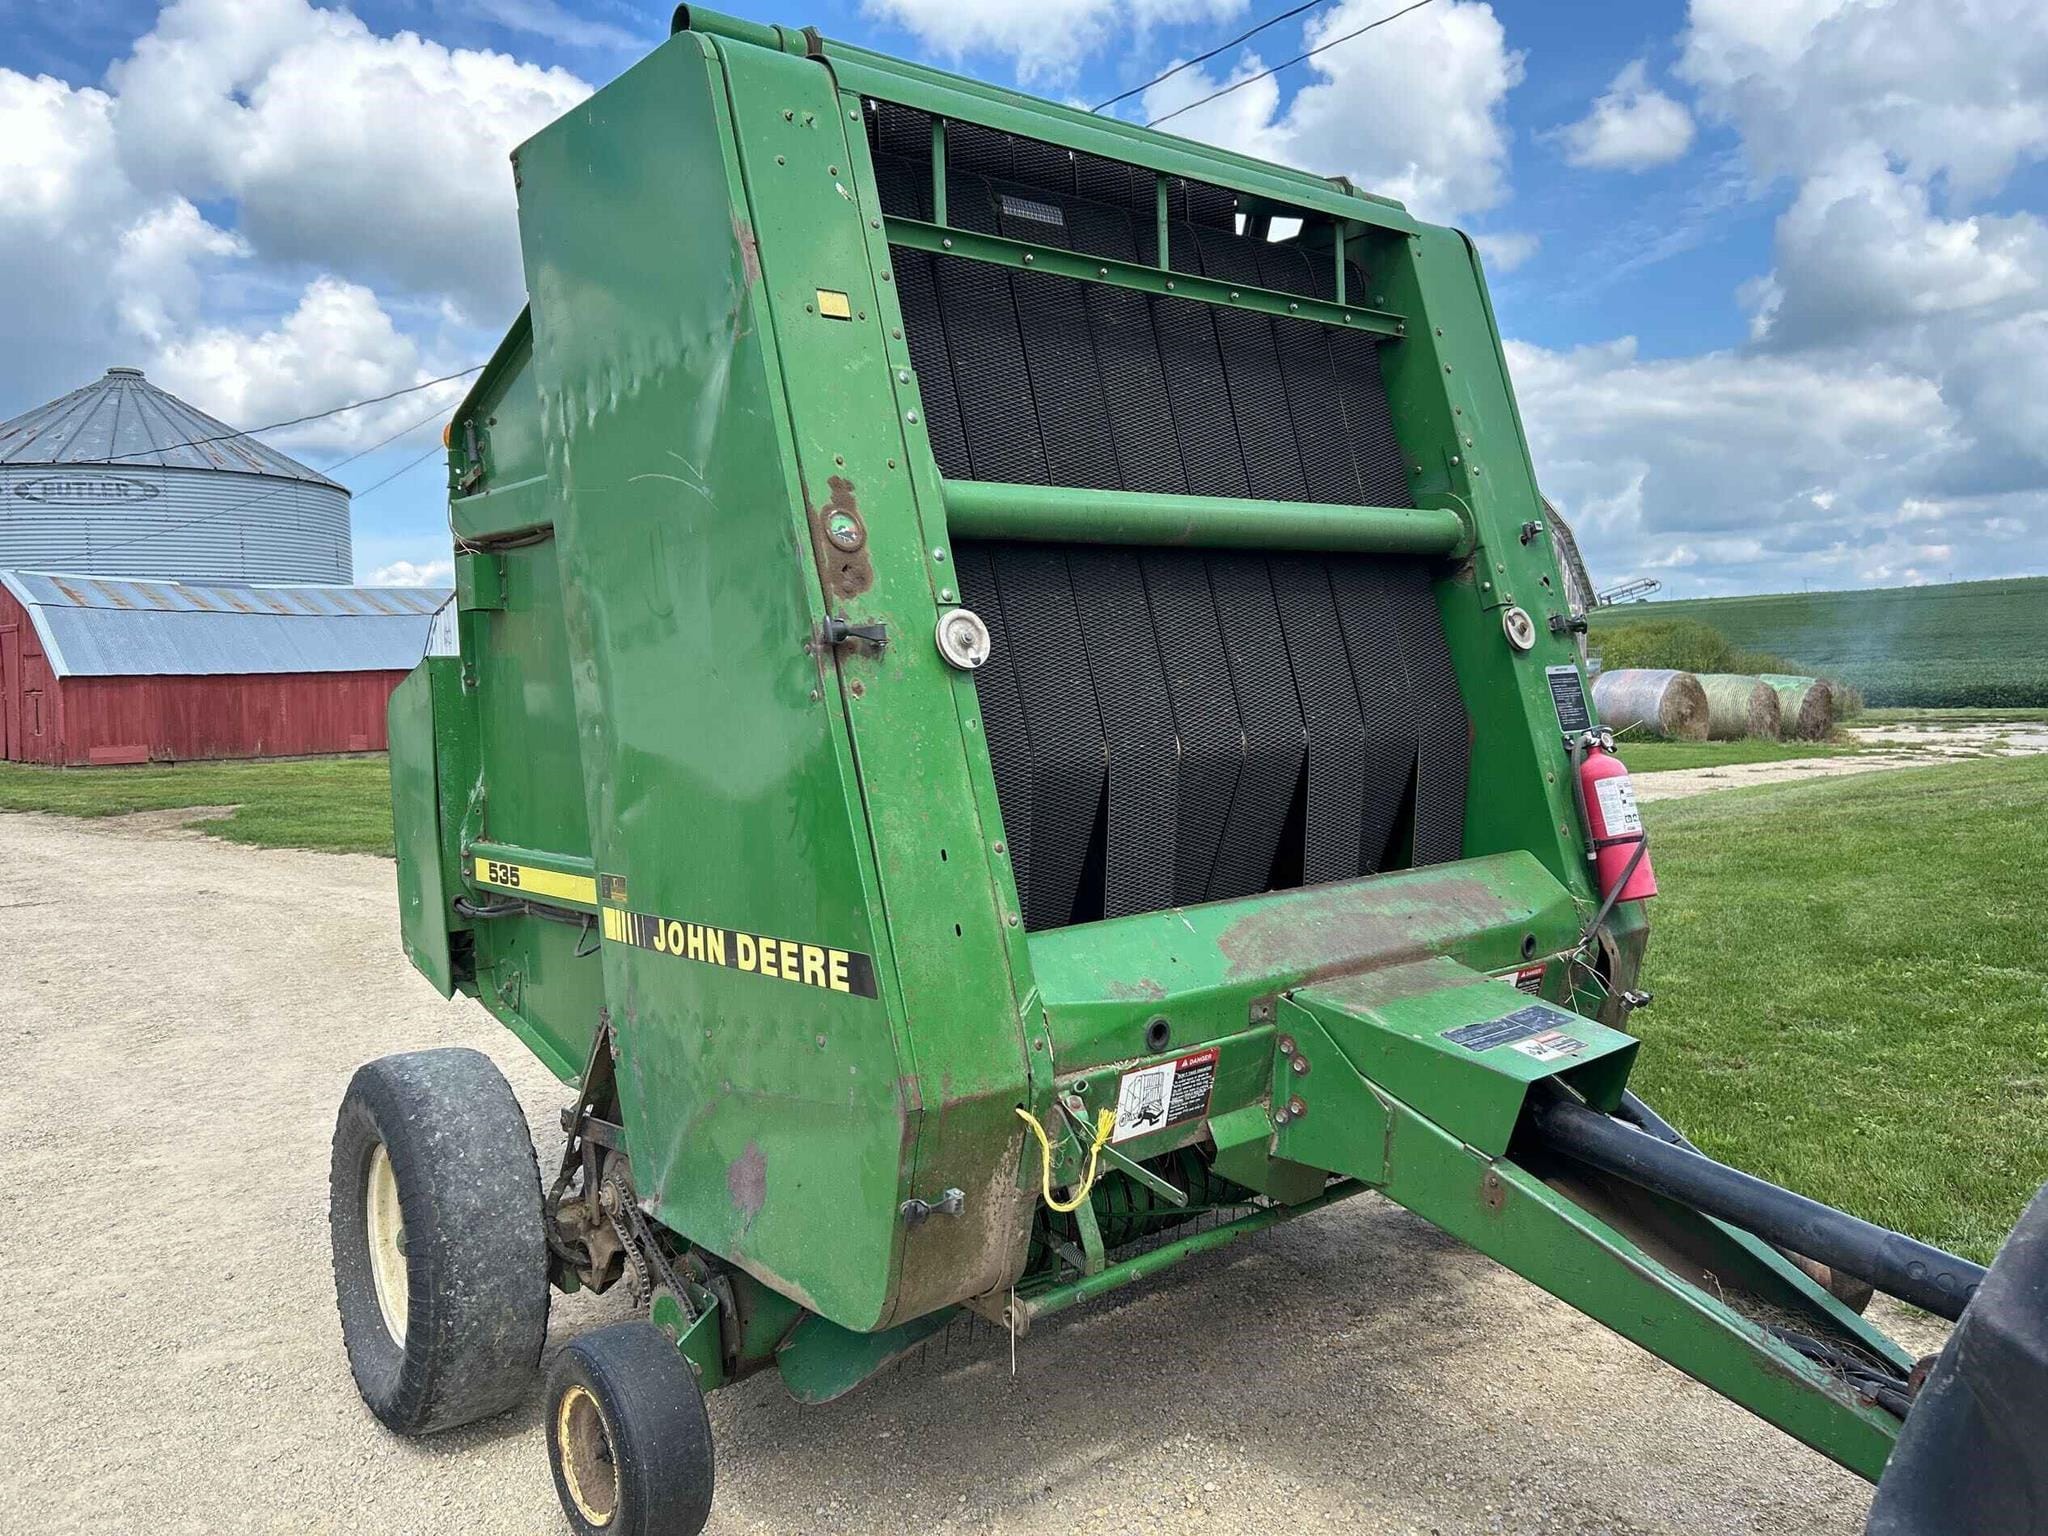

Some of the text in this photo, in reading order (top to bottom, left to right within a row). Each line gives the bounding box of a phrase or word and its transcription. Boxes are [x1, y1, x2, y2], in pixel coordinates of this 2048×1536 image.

[488, 862, 521, 887] 535
[653, 918, 851, 993] JOHN DEERE
[1189, 1054, 1213, 1065] DANGER
